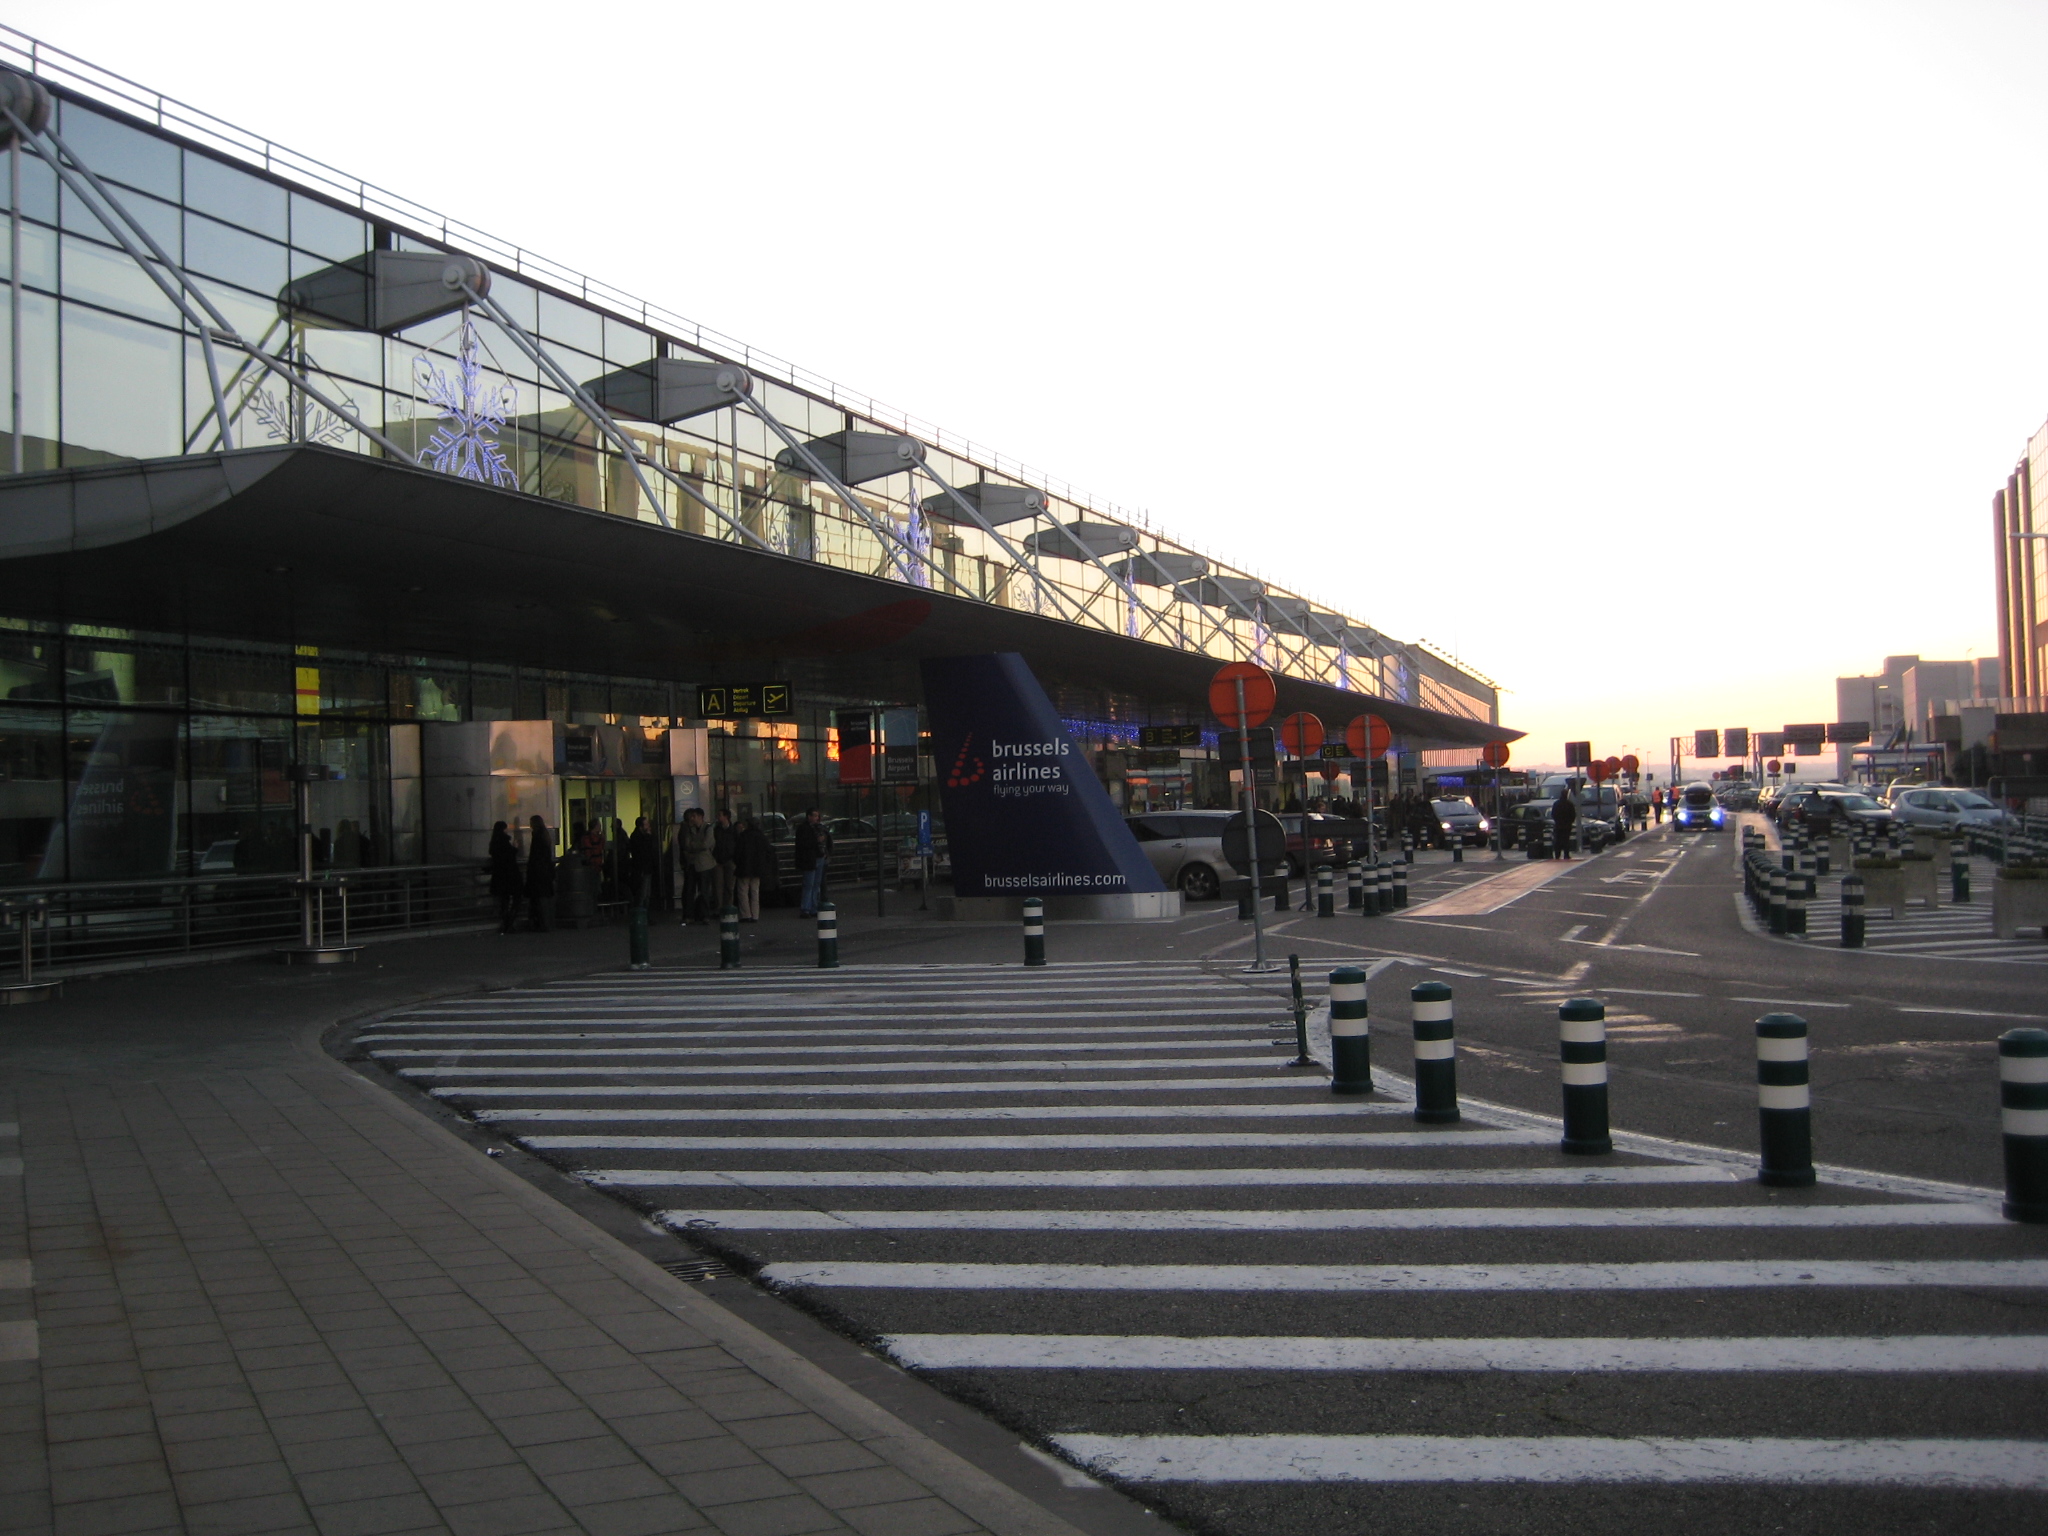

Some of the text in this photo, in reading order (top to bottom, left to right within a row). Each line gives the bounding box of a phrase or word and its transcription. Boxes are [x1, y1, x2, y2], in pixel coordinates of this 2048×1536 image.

[707, 694, 721, 711] A
[1145, 731, 1154, 742] B
[992, 738, 1069, 758] brussels
[1324, 747, 1332, 756] C
[887, 764, 910, 772] Airport
[992, 762, 1060, 781] airlines
[993, 784, 1069, 798] flying your way
[920, 811, 928, 830] P
[984, 872, 1126, 888] brusselsairlines.com
